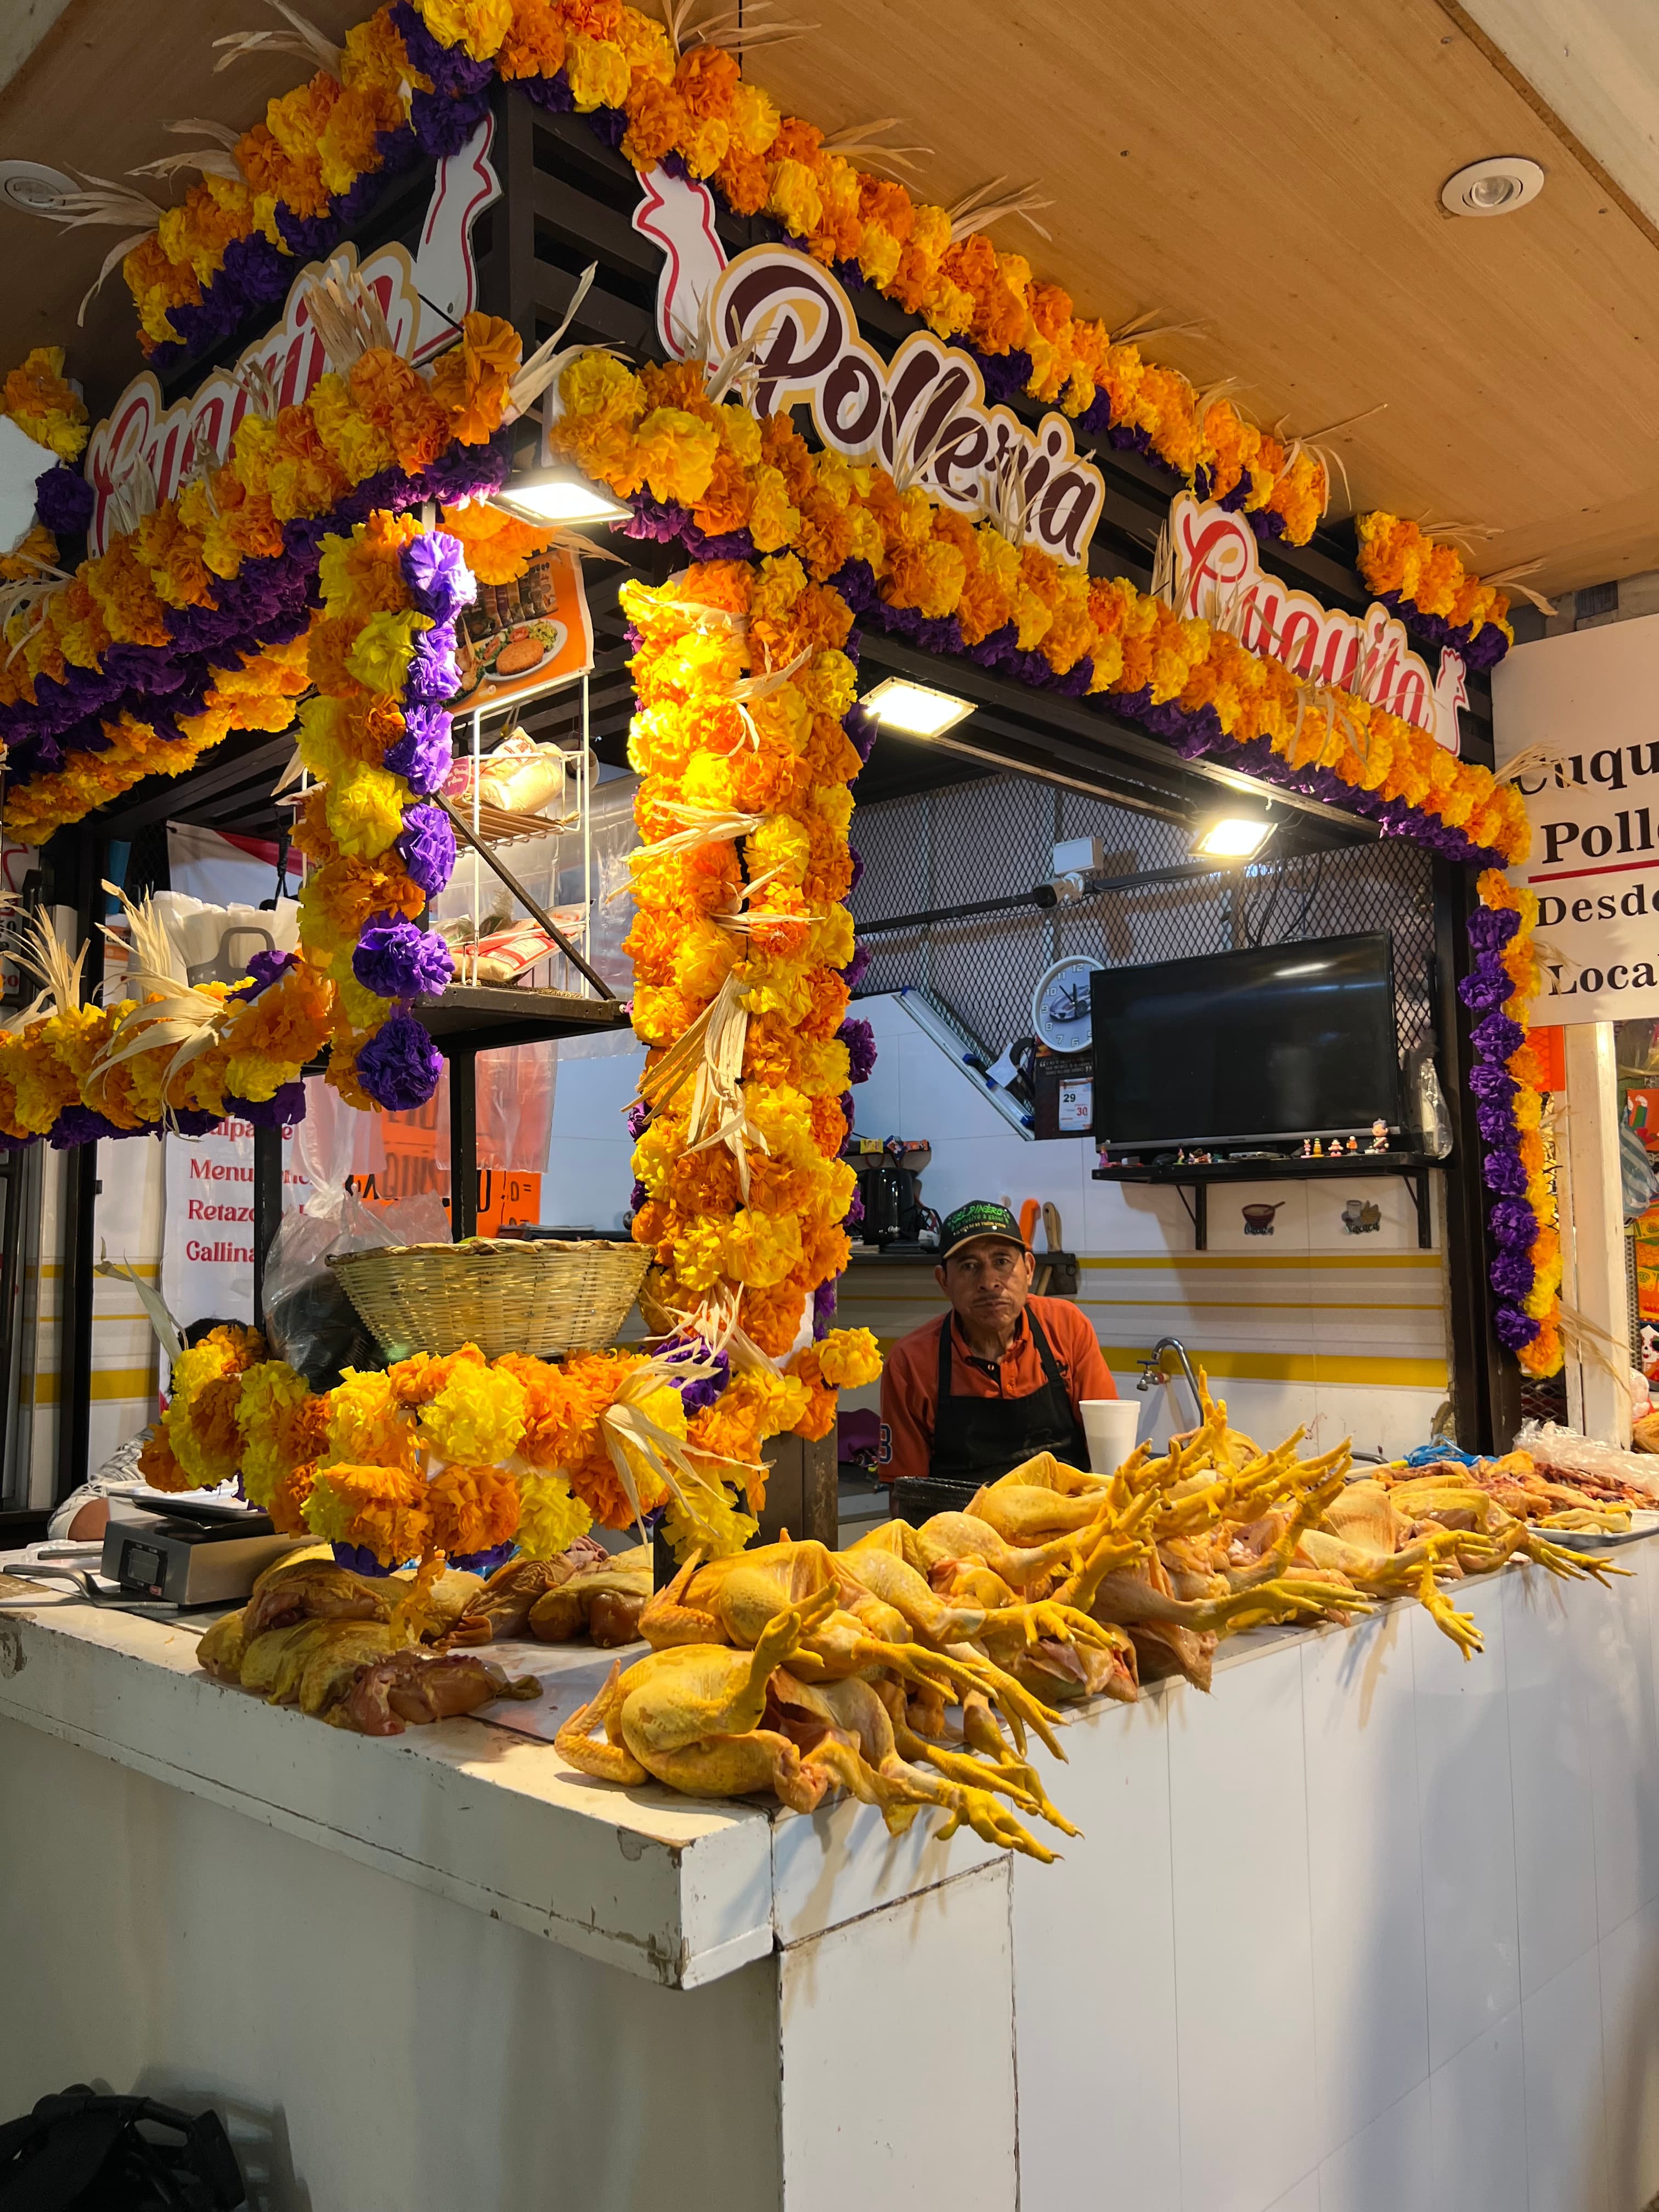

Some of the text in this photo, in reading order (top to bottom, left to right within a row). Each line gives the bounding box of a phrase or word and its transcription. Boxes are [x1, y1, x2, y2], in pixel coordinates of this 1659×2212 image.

[1541, 808, 1659, 864] Poll
[1072, 963, 1084, 973] 12
[1057, 971, 1066, 980] 11
[1046, 988, 1057, 996] 10
[1041, 1005, 1048, 1013] 9
[1045, 1022, 1052, 1031] 8
[1056, 1035, 1063, 1044] 7
[1071, 1038, 1079, 1047] 6
[1063, 1093, 1076, 1103] 29
[1077, 1107, 1088, 1116] 30
